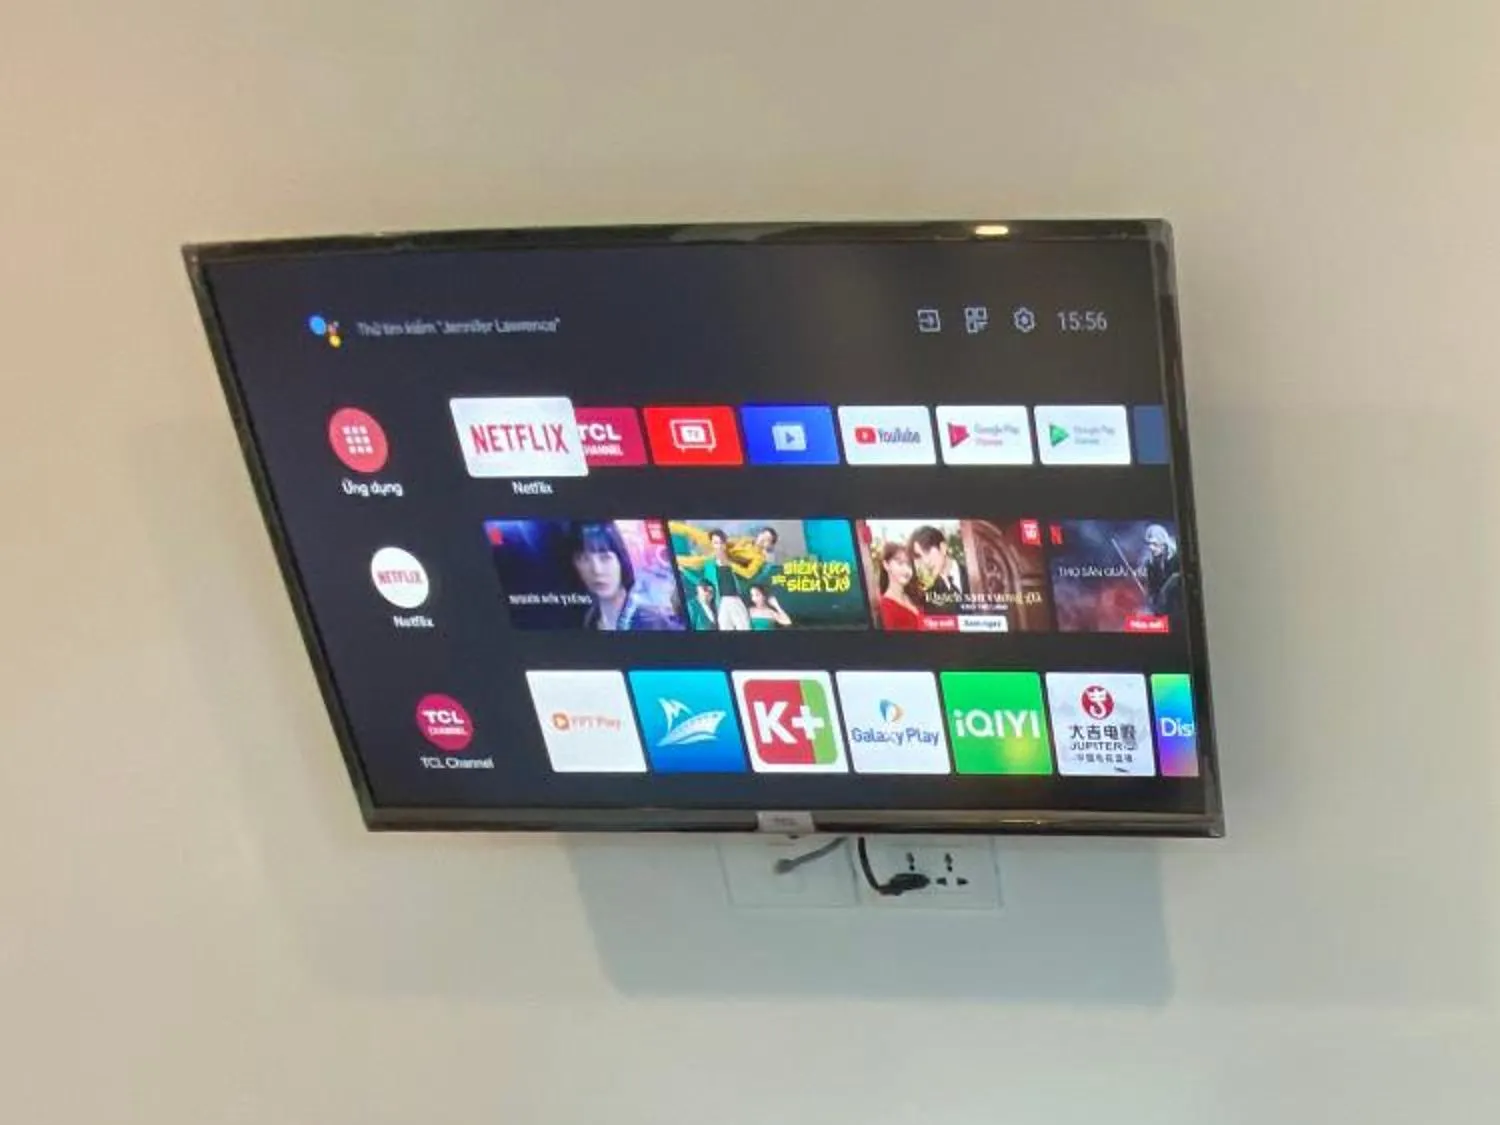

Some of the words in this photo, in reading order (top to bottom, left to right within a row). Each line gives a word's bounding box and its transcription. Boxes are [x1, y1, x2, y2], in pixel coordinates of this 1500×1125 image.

[1057, 311, 1108, 331] 15:56
[470, 423, 570, 455] NETFLIX
[577, 424, 623, 441] TCL
[512, 481, 552, 495] Netflix
[377, 569, 423, 585] NETFLIX
[393, 615, 435, 628] Netflix
[422, 710, 464, 724] TCL
[753, 700, 825, 745] K+
[954, 709, 1041, 738] iQIYI
[851, 727, 904, 747] Galaxy
[907, 728, 940, 747] Play
[420, 756, 446, 769] TCL
[446, 756, 494, 769] Channel
